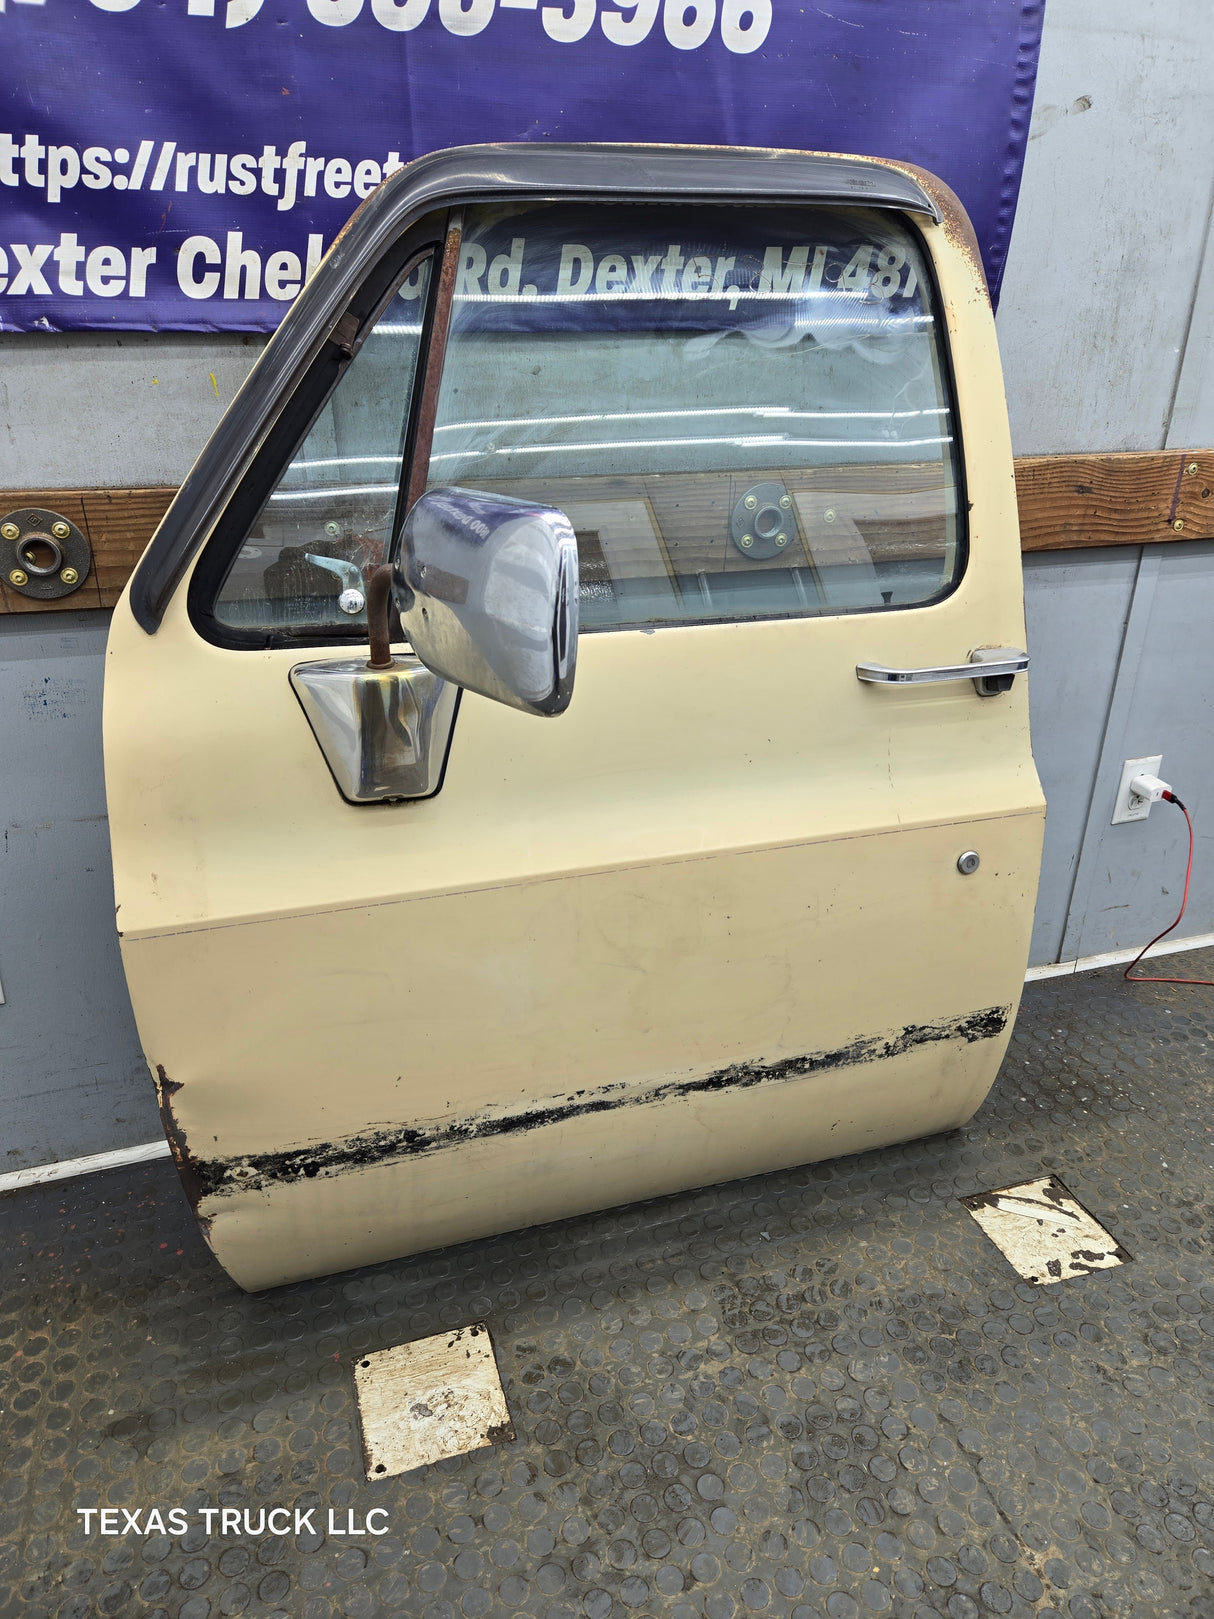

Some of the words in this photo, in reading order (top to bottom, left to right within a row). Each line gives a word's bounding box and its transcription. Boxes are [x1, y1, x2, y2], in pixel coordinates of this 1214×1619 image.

[0, 233, 156, 298] xter
[453, 238, 538, 301] Rd.
[556, 244, 740, 311] Dexter,
[757, 246, 828, 298] MI
